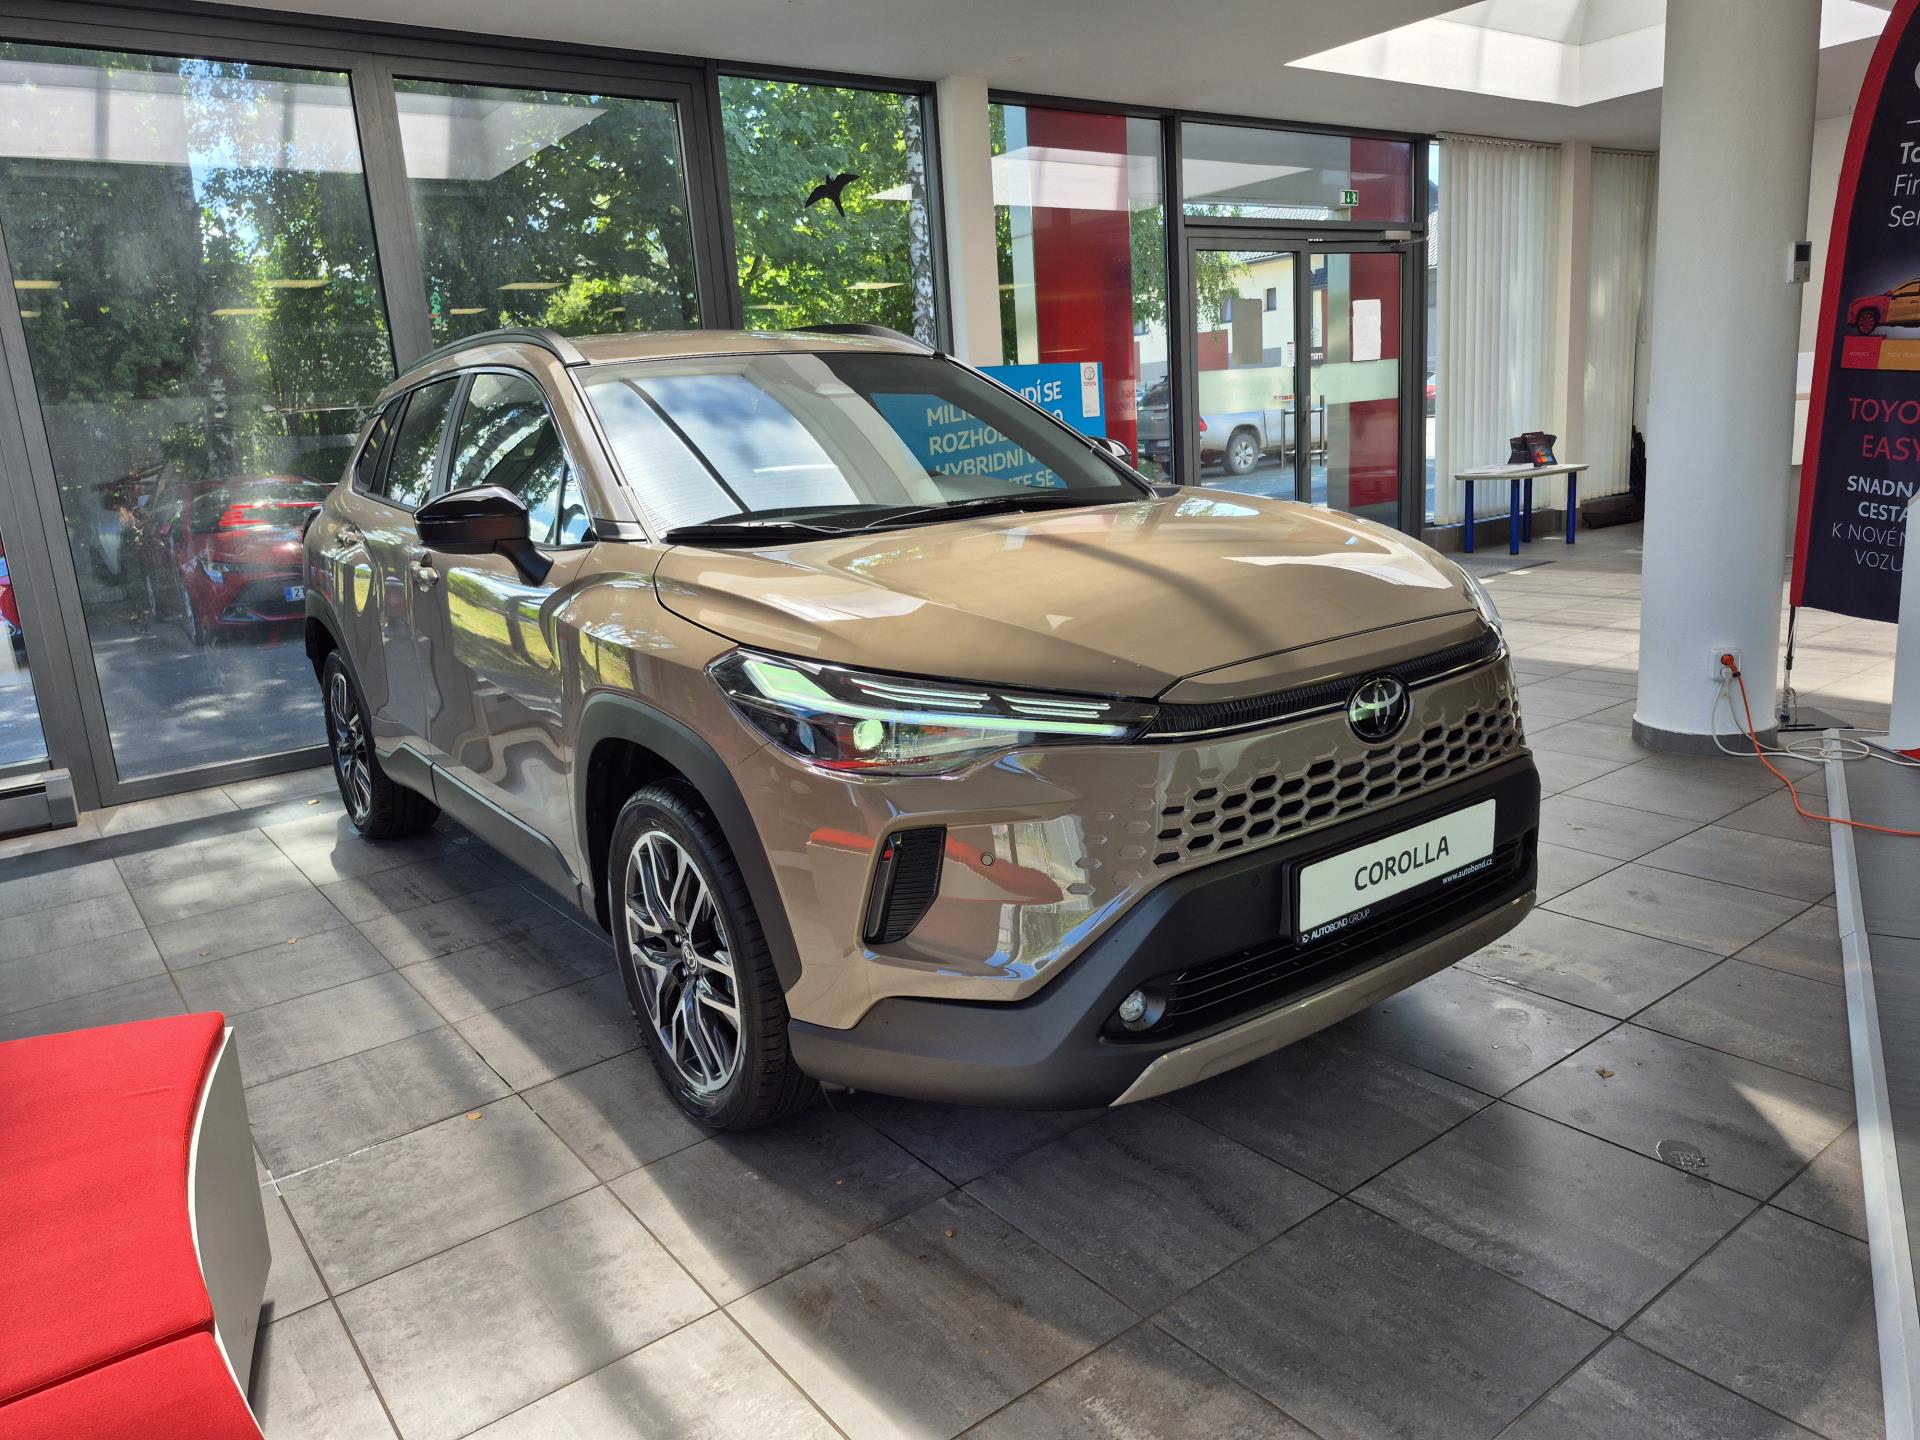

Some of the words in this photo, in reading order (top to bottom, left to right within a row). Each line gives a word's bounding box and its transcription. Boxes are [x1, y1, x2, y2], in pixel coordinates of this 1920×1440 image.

[1043, 380, 1063, 402] SE
[1849, 398, 1920, 425] TOYO
[928, 425, 1009, 456] ROZHO
[1035, 469, 1056, 488] SE
[1846, 475, 1920, 499] SNADN
[1832, 522, 1844, 539] K
[1854, 549, 1904, 572] VOZU
[1353, 835, 1450, 891] COROLLA
[1441, 858, 1493, 885] www.autobond.cz
[1310, 917, 1349, 941] AUTOBOND
[1349, 908, 1371, 924] GROUP
